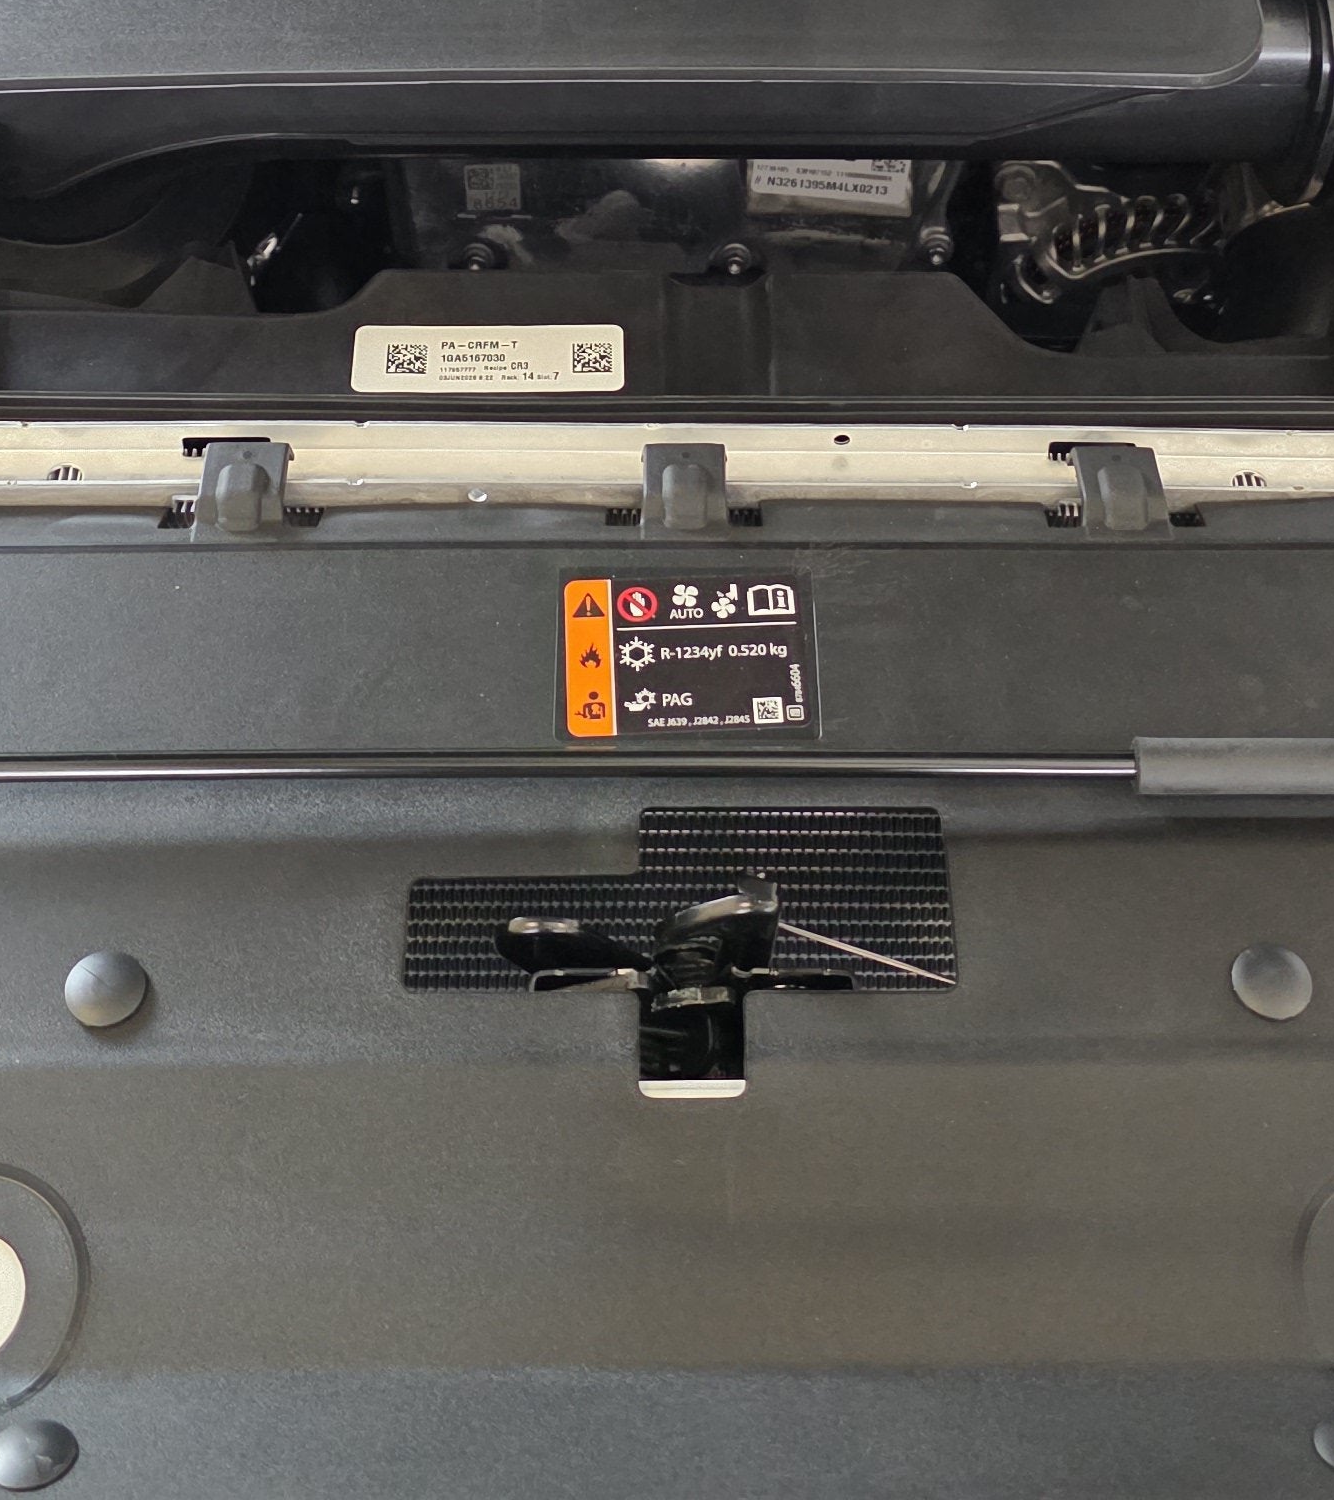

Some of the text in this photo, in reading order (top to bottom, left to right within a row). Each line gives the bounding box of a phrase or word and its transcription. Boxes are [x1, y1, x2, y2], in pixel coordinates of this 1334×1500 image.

[511, 362, 529, 370] CR3
[523, 372, 534, 381] 14
[553, 371, 560, 381] 7
[670, 608, 704, 619] AUTO
[660, 642, 788, 661] R-1234yf 0.520 kg
[663, 692, 693, 707] PAG
[647, 717, 666, 727] SAE
